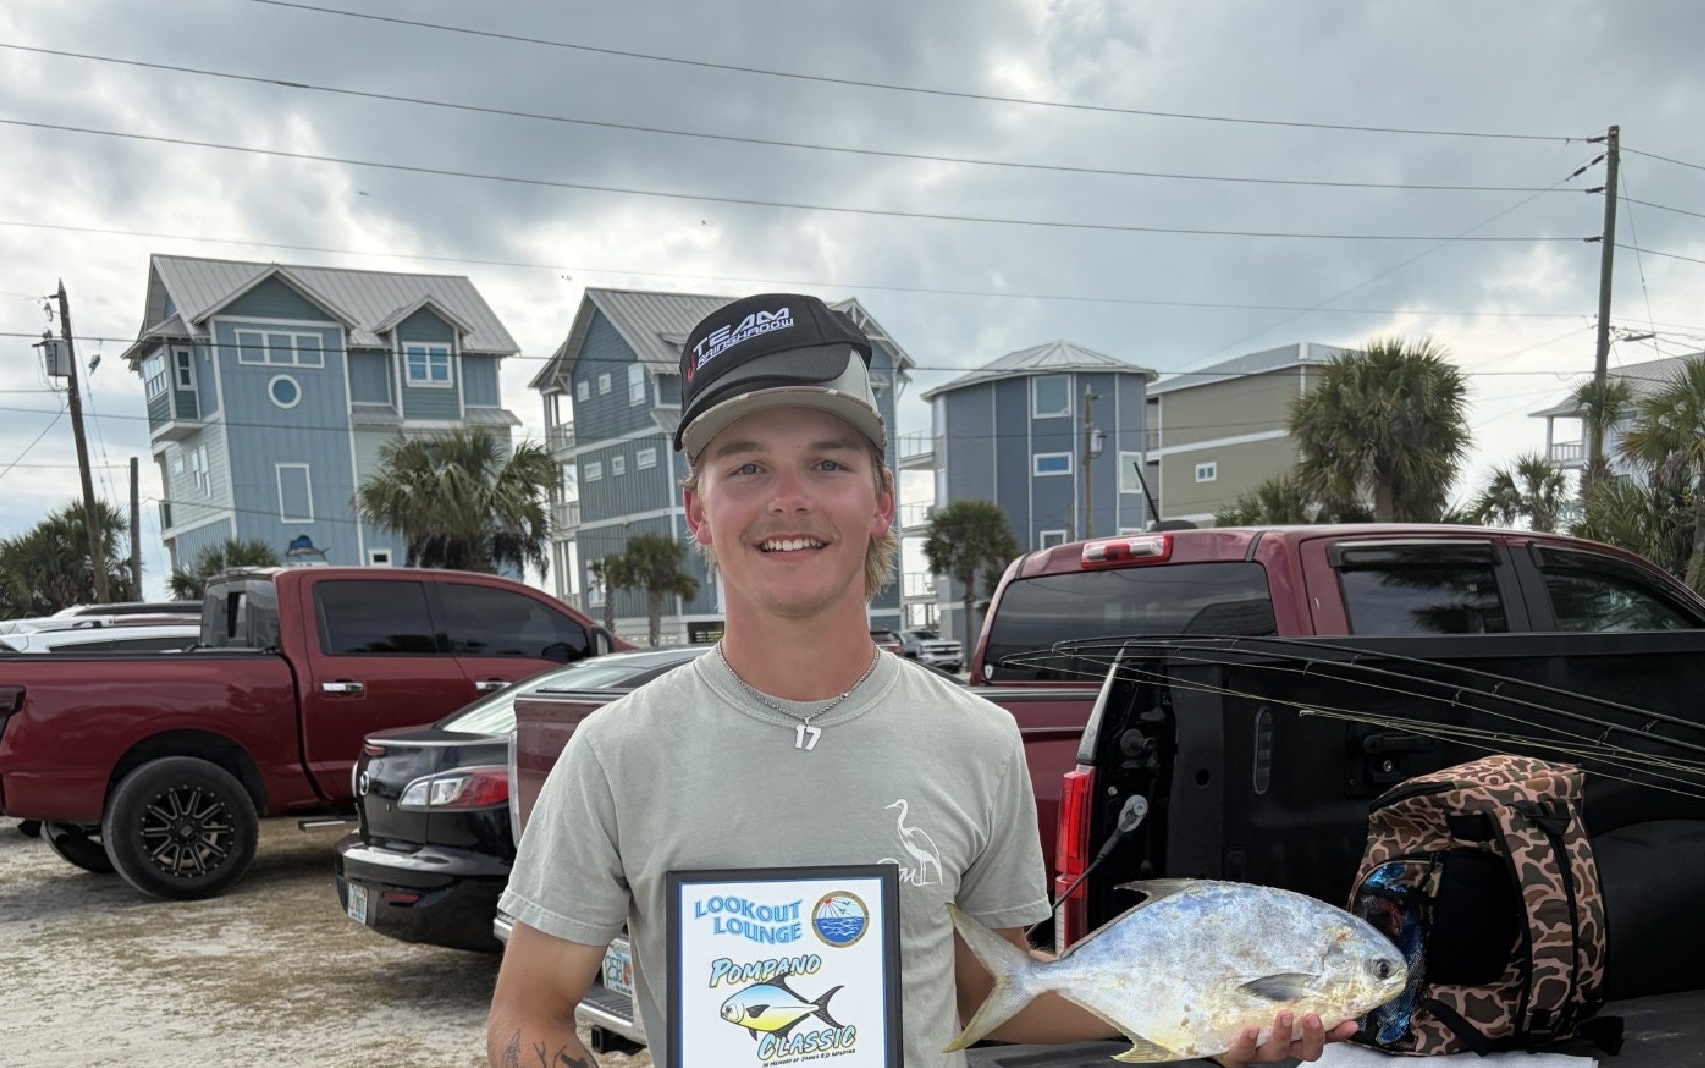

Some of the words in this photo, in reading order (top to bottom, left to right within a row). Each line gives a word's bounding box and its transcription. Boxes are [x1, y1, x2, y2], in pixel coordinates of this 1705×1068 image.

[693, 307, 790, 357] TEAM
[795, 726, 822, 750] 17
[694, 895, 804, 923] LOOKOUT
[713, 916, 802, 944] LOUNGE
[709, 954, 822, 988] POMPANO
[757, 1025, 856, 1061] CLASSIC
